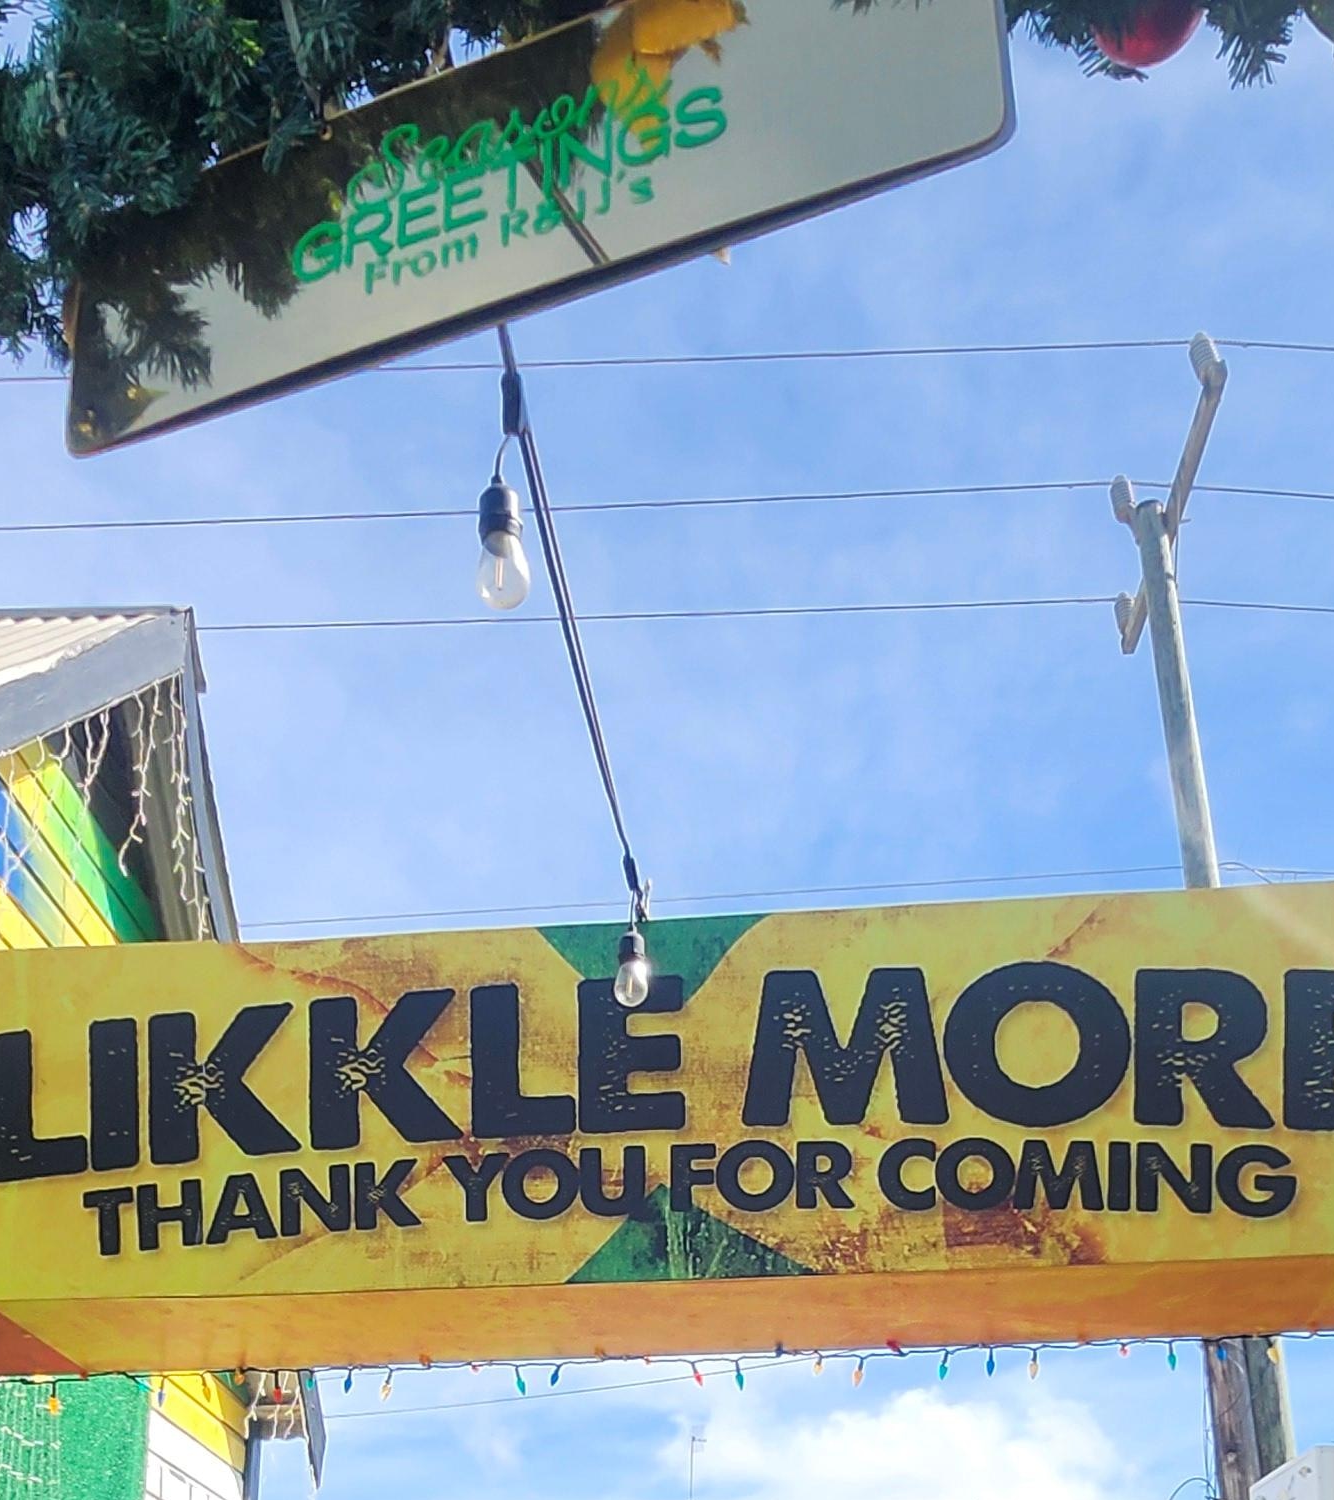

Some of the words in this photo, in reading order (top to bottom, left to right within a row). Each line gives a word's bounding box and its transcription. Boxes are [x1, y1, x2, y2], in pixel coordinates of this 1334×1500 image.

[291, 86, 728, 284] GREETINGS
[364, 235, 479, 294] From
[82, 1157, 423, 1257] THANK
[442, 1143, 649, 1224] YOU
[669, 1138, 854, 1212] FOR
[876, 1136, 1298, 1219] COMING
